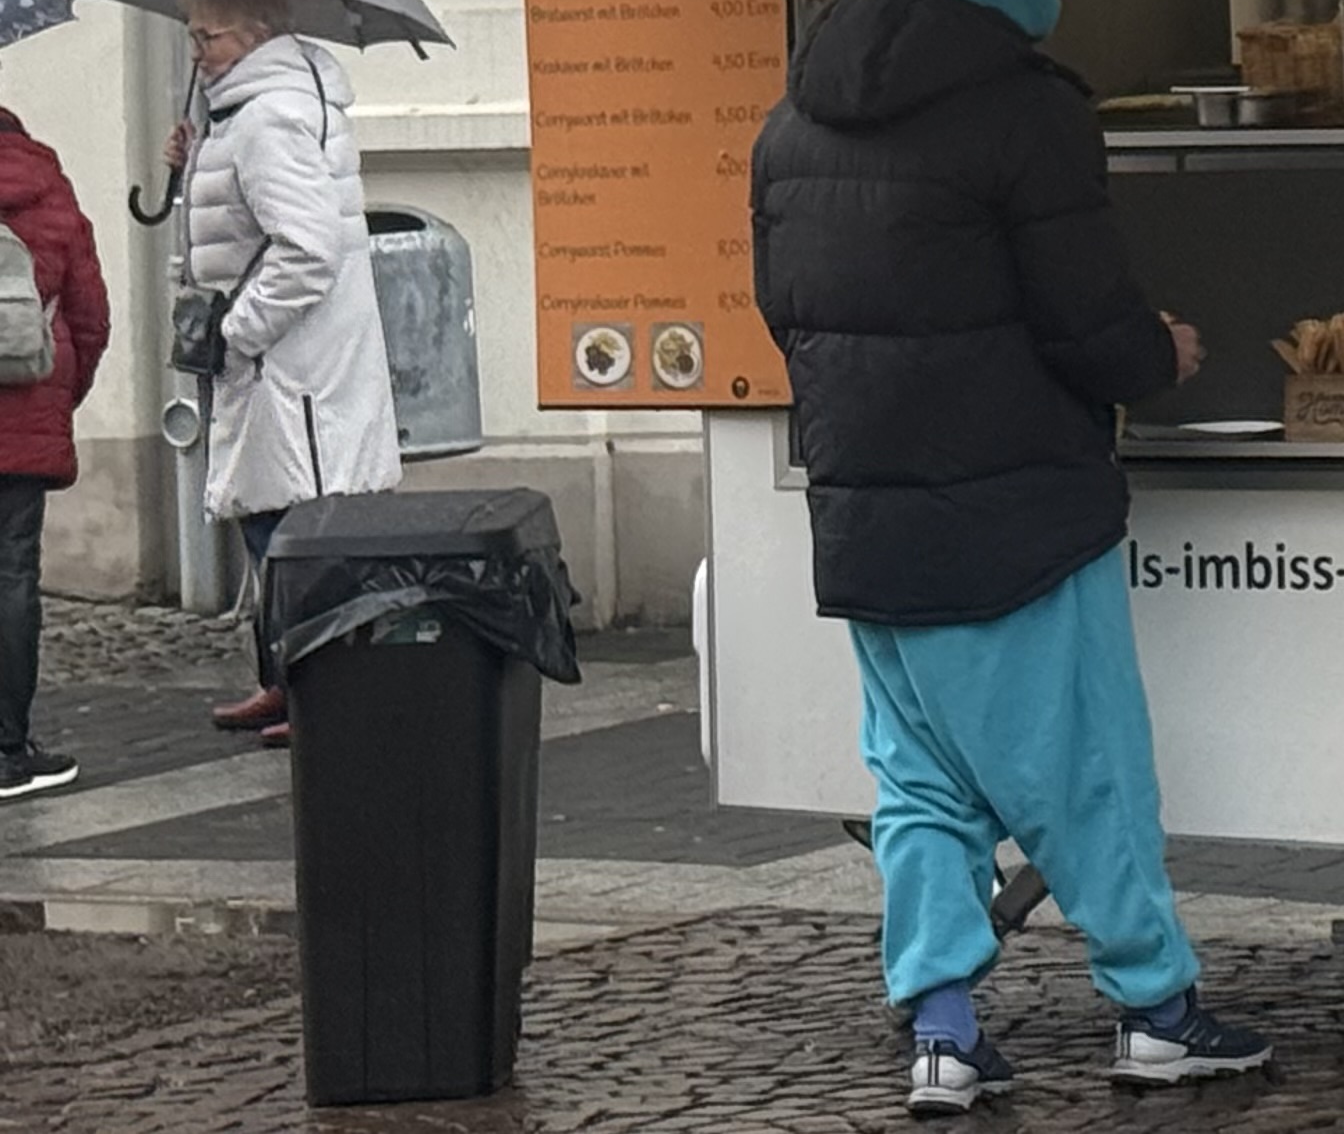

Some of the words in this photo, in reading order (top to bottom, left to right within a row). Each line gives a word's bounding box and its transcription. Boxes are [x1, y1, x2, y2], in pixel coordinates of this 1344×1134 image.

[746, 0, 780, 16] Euro
[748, 52, 781, 69] Euro
[535, 110, 608, 132] Currywurst
[633, 294, 687, 311] Pommes
